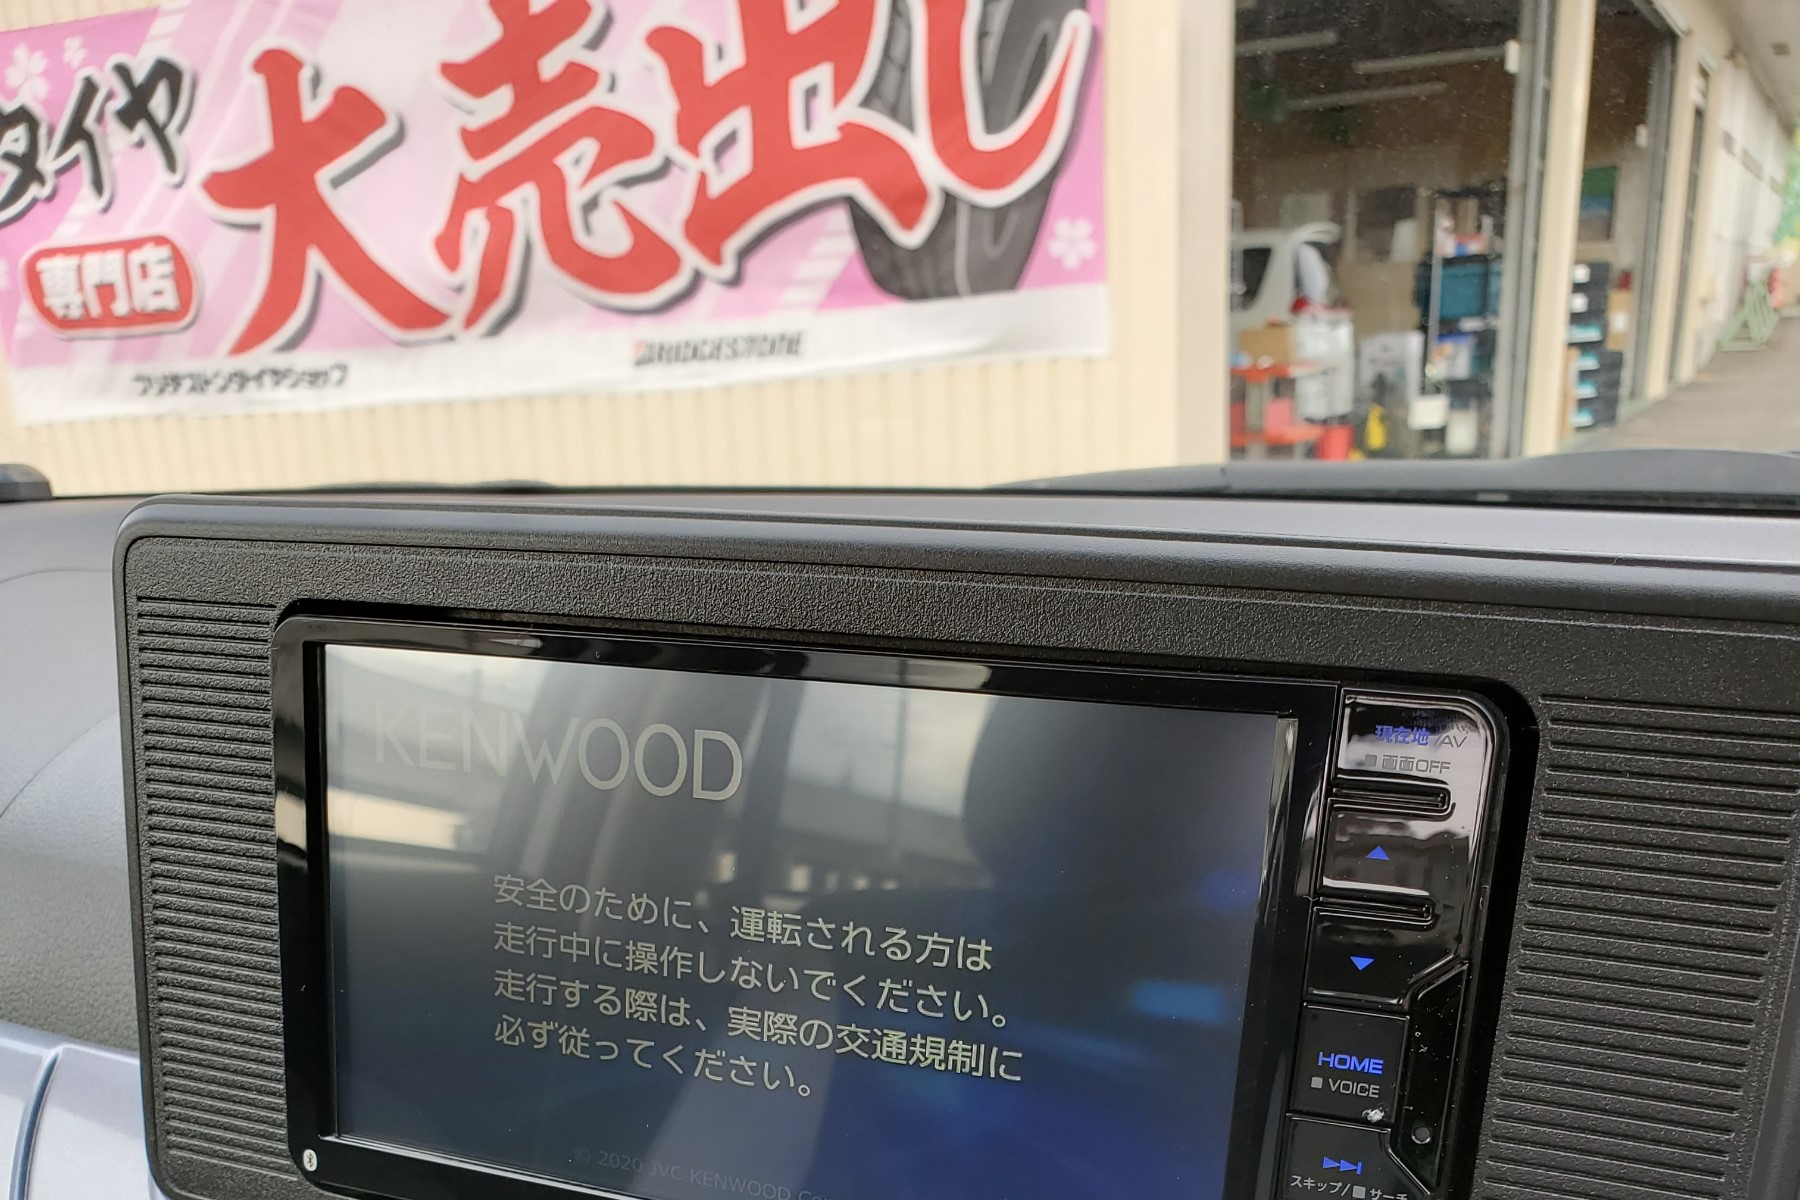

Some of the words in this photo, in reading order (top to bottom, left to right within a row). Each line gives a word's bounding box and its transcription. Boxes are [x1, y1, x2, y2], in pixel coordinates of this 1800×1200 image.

[0, 57, 184, 214] タイヤ
[35, 243, 181, 321] 専門店
[375, 699, 743, 801] KENWOOD
[493, 873, 993, 972] 安全のために、運転される方は
[493, 921, 1006, 1028] 走行中に操作しないでください。
[493, 968, 1023, 1082] 走行する際は、実際の交通規制に
[493, 1013, 811, 1097] 必ず従ってください。
[1317, 1051, 1385, 1075] HOME
[1328, 1079, 1380, 1099] VOICE
